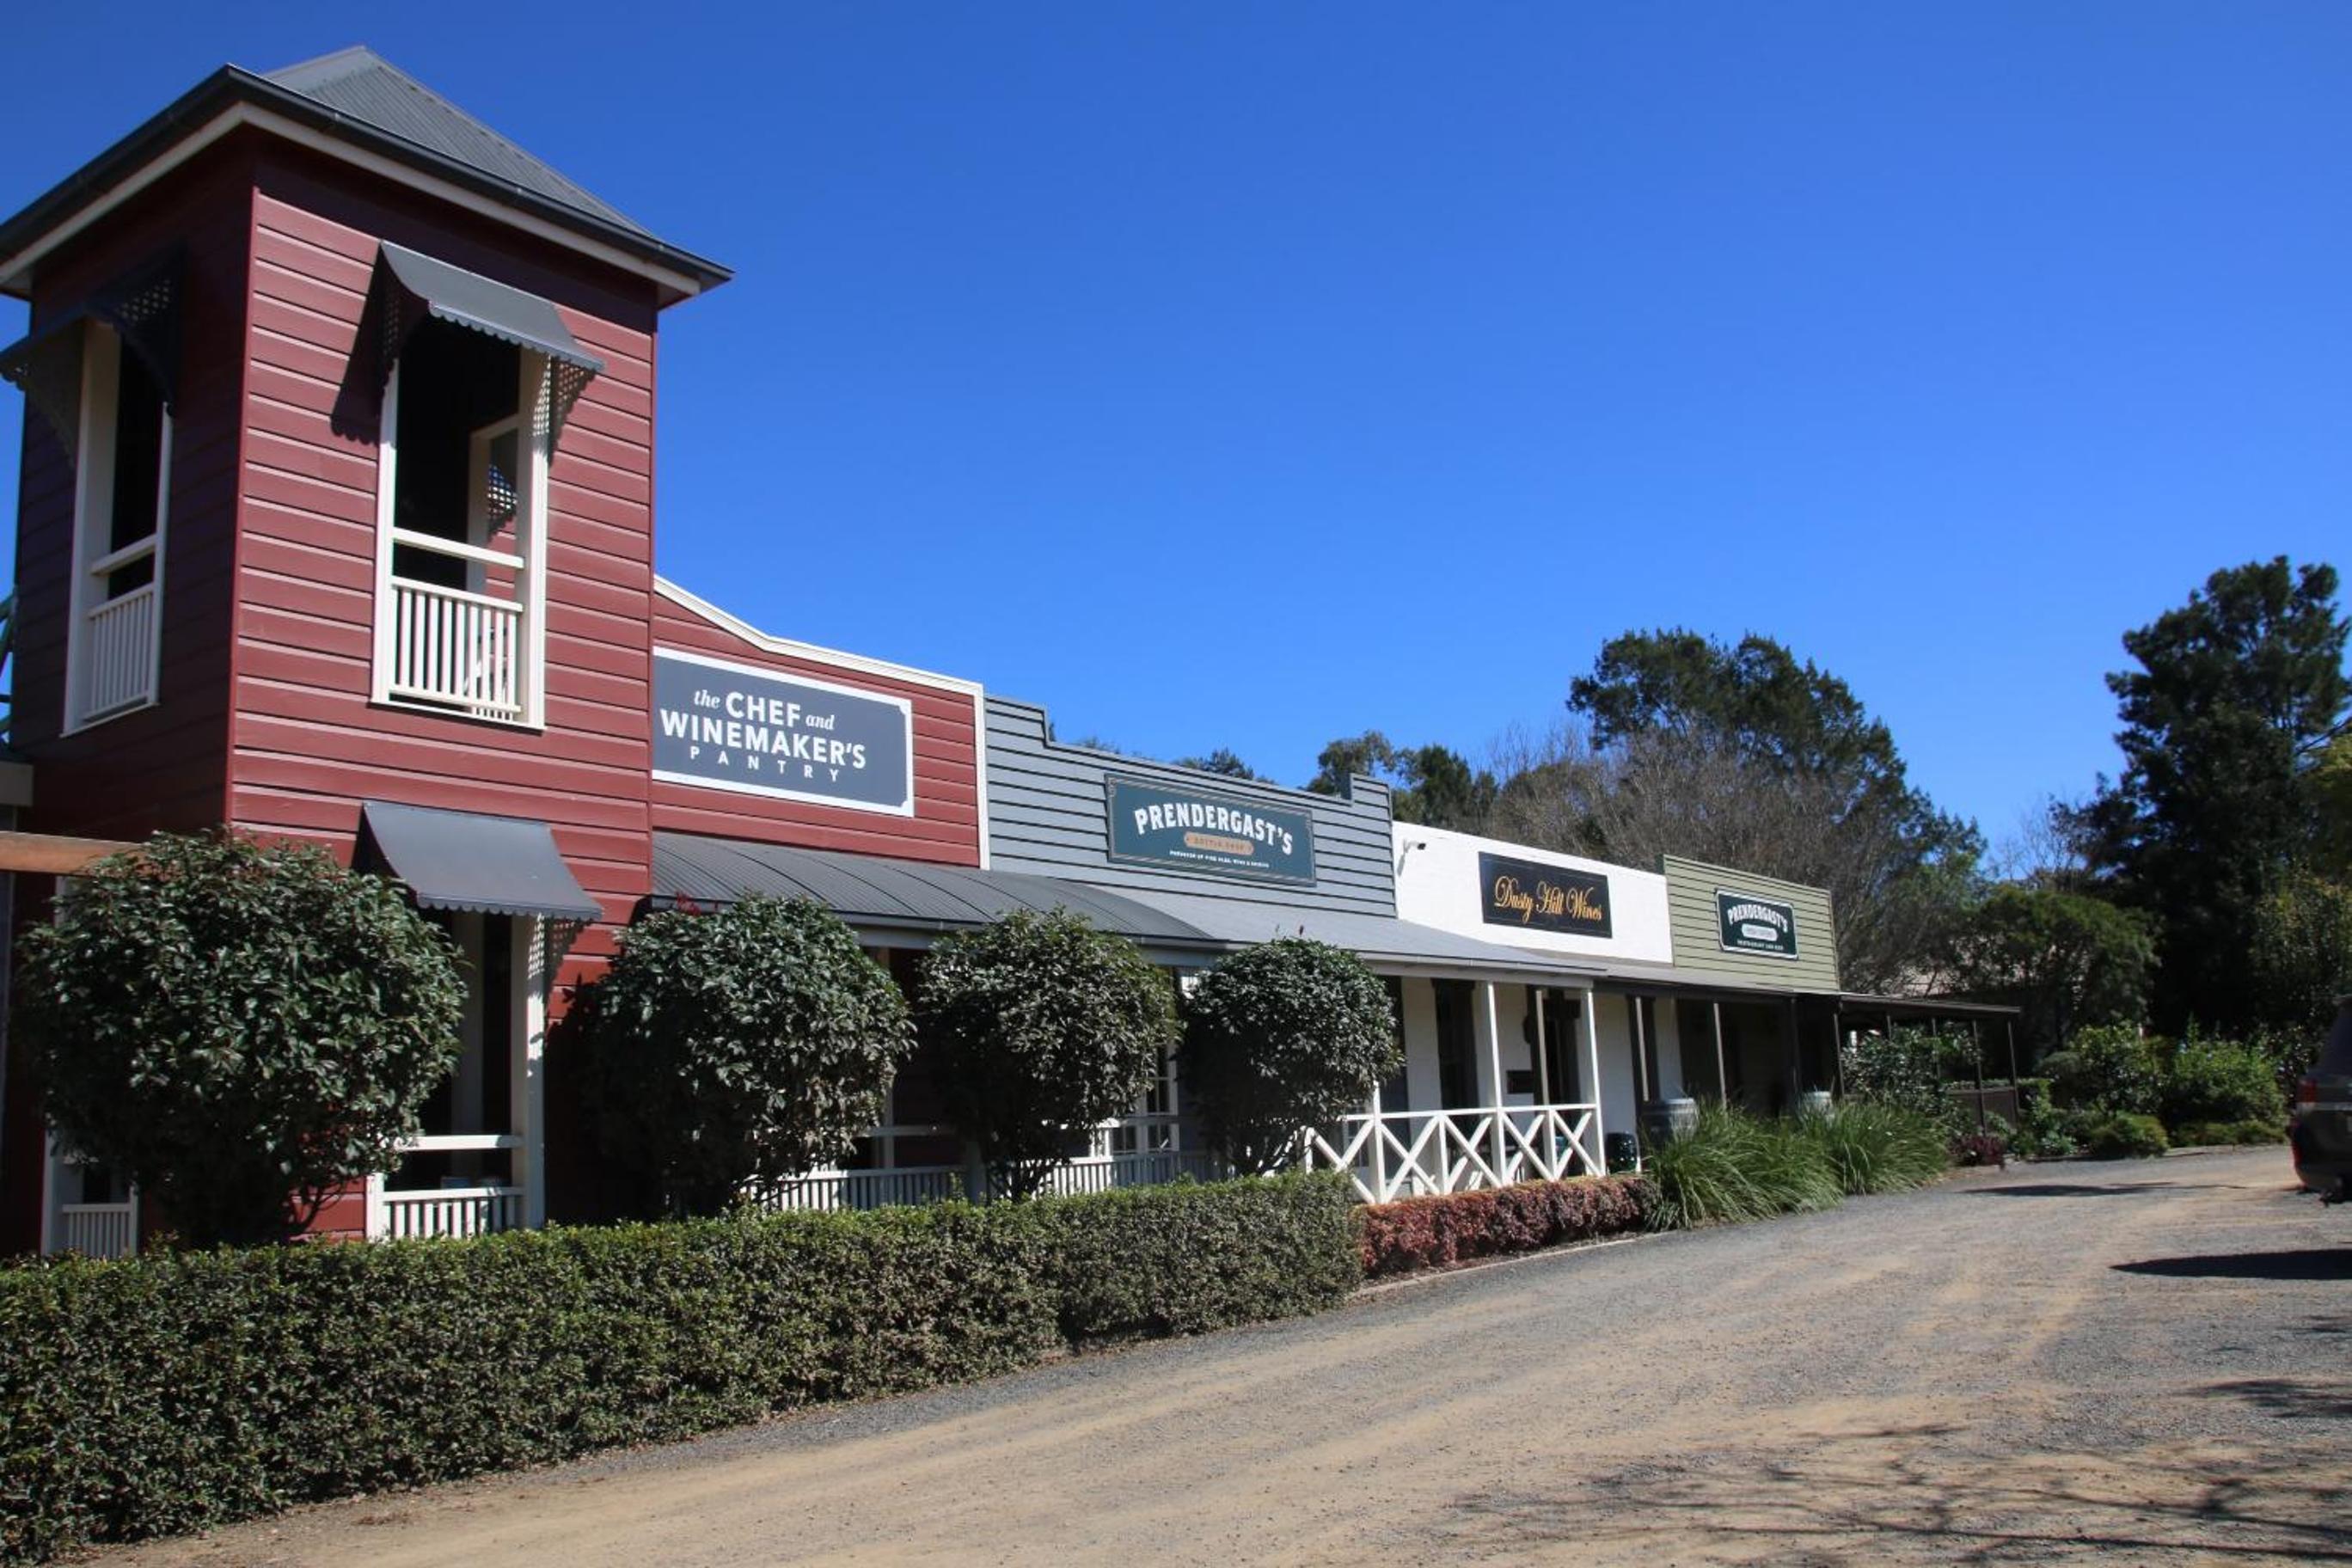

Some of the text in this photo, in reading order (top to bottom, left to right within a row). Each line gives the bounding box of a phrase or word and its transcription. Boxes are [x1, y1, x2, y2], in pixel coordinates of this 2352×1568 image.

[694, 689, 835, 731] the CHEF and
[660, 708, 866, 769] WINEMAKER'S
[690, 745, 839, 783] PANTRY
[1135, 803, 1294, 855] PRENDERGAST'S
[1536, 880, 1564, 916] Hill
[1727, 904, 1788, 933] PRENDERGAST'S
